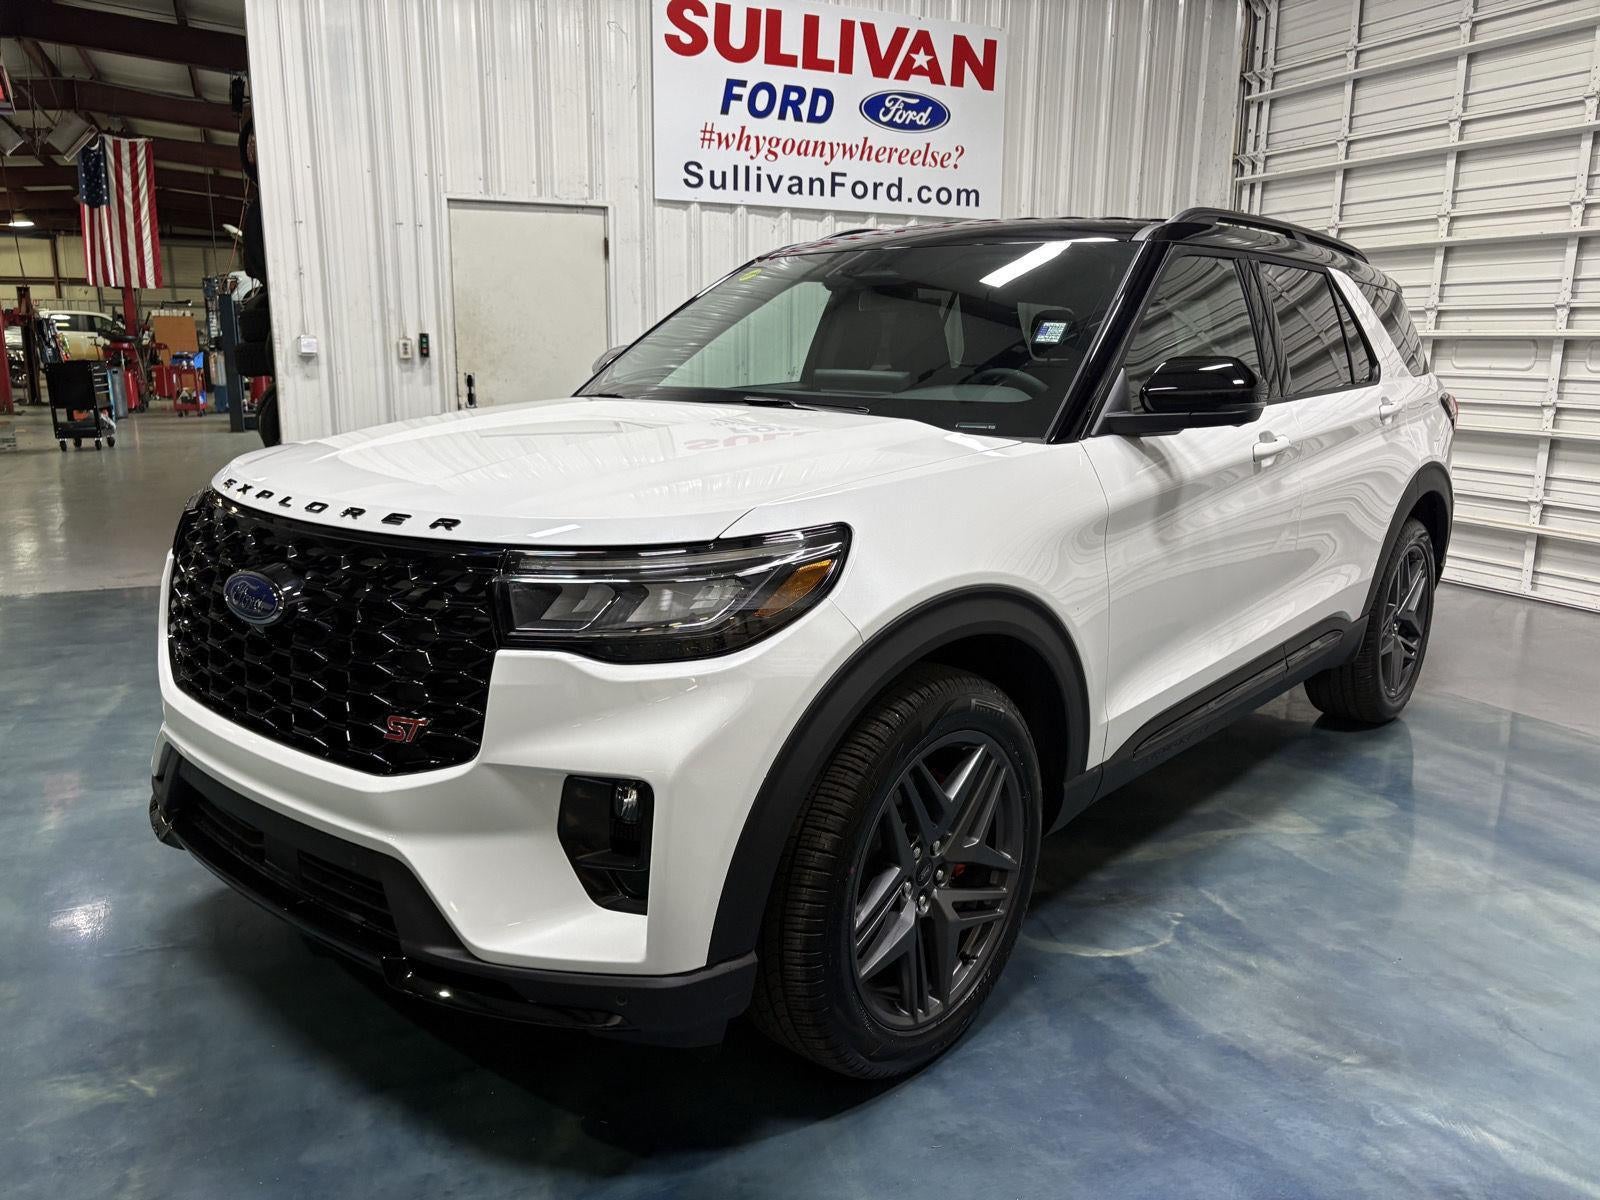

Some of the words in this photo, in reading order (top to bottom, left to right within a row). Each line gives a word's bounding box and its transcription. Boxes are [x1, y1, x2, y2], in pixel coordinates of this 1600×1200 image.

[664, 0, 998, 92] SULLIVAN
[720, 77, 835, 125] FORD
[877, 93, 932, 128] Ford
[700, 122, 966, 171] #whygoanywhereelse?
[682, 160, 981, 208] SullivanFord.com
[223, 478, 462, 532] EXPLORER
[383, 715, 429, 743] ST
